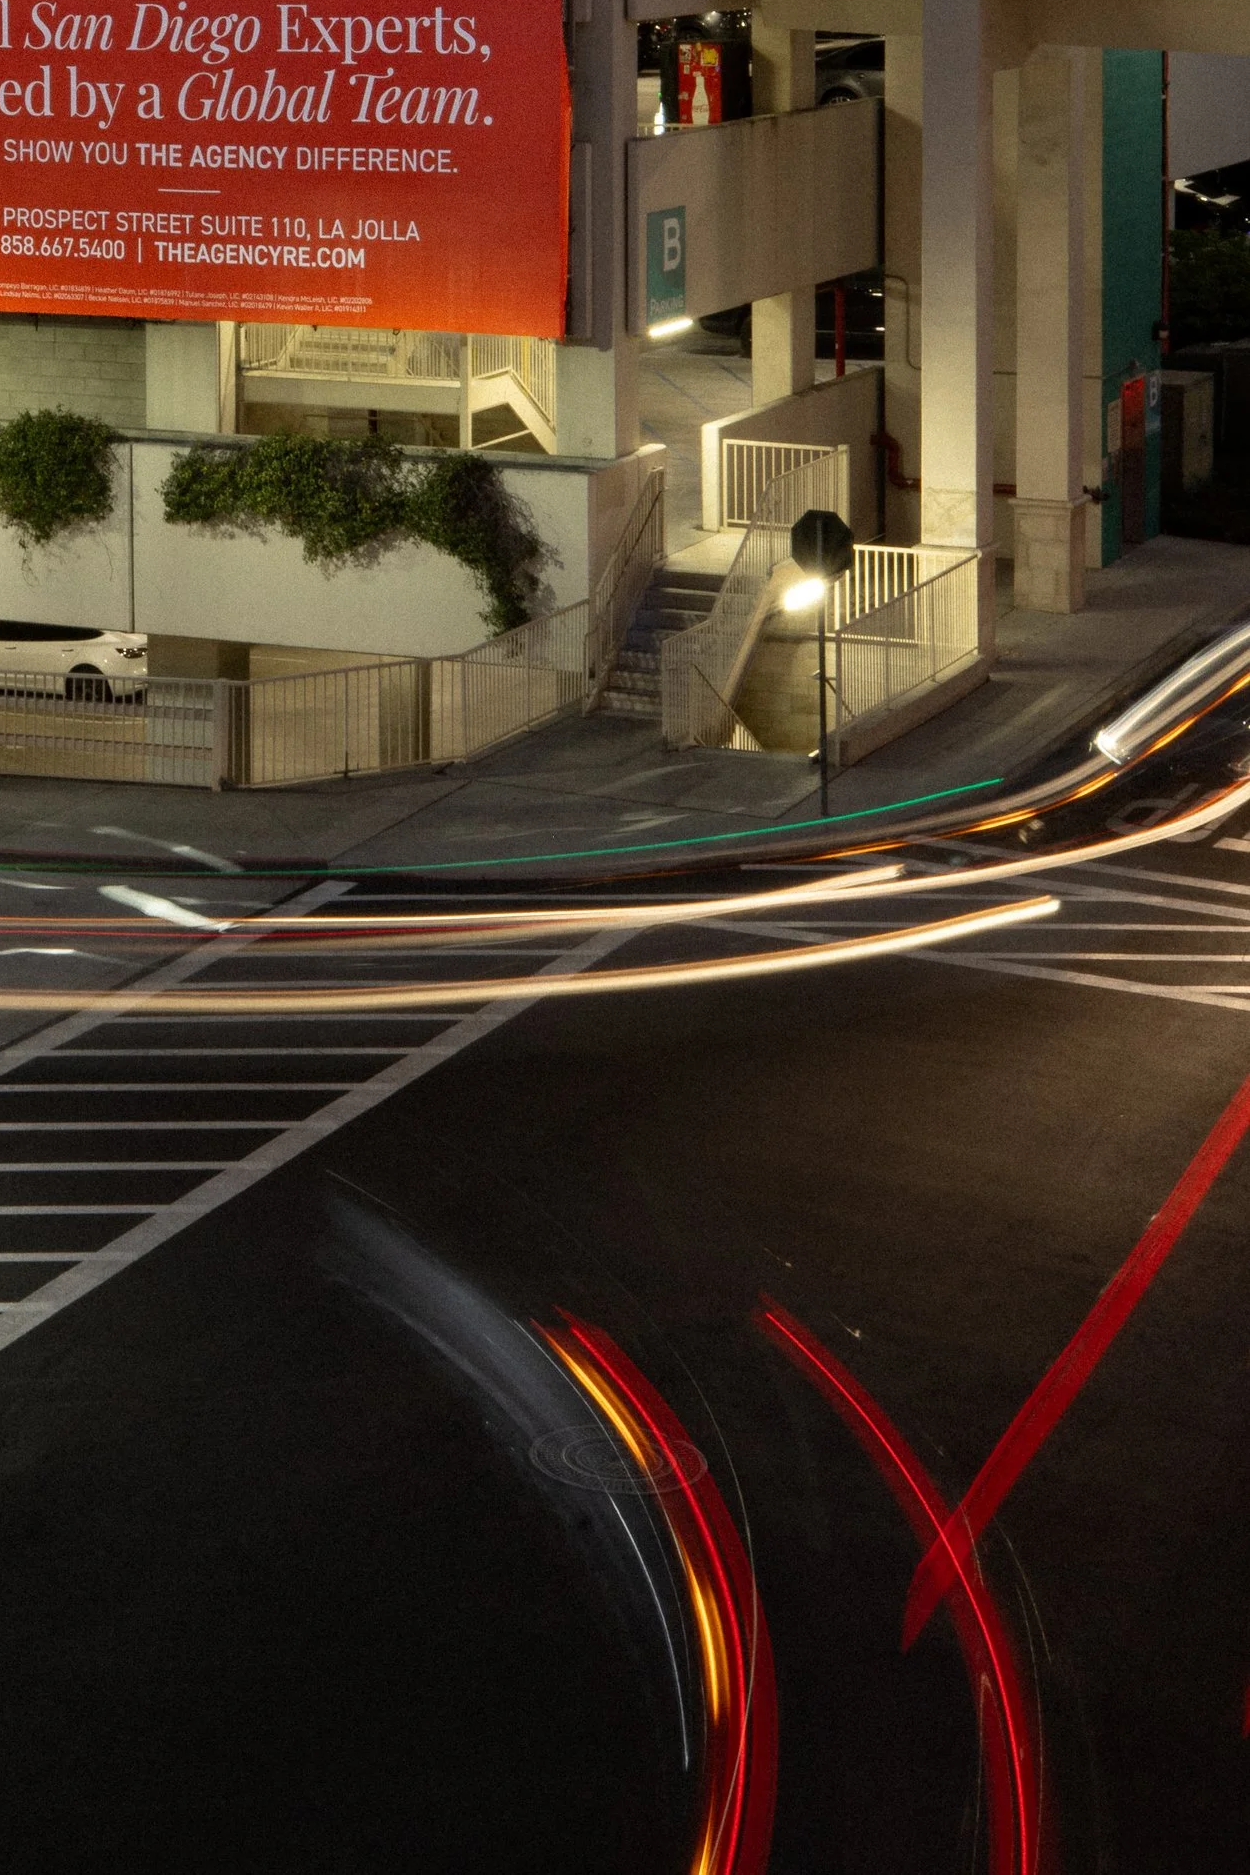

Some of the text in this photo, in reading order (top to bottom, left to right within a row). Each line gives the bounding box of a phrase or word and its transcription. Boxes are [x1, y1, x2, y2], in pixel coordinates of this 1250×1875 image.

[24, 2, 112, 50] San
[126, 1, 260, 64] Diego
[277, 4, 490, 64] Experts,
[67, 66, 125, 129] by
[138, 83, 164, 119] a
[178, 68, 334, 123] Global
[349, 68, 493, 125] Team.
[4, 139, 73, 163] SHOW
[80, 142, 127, 165] YOU
[136, 143, 182, 167] THE
[190, 145, 287, 169] AGENCY
[297, 147, 457, 173] DIFFERENCE.
[4, 207, 110, 230] PROSPECT
[116, 212, 194, 234] STREET
[201, 215, 262, 236] SUITE
[272, 217, 310, 241] 110,
[319, 219, 345, 239] LA
[352, 220, 420, 241] JOLLA
[663, 217, 681, 271] B
[1, 235, 365, 268] 858.667.5400 THEAGENCYRE.COM
